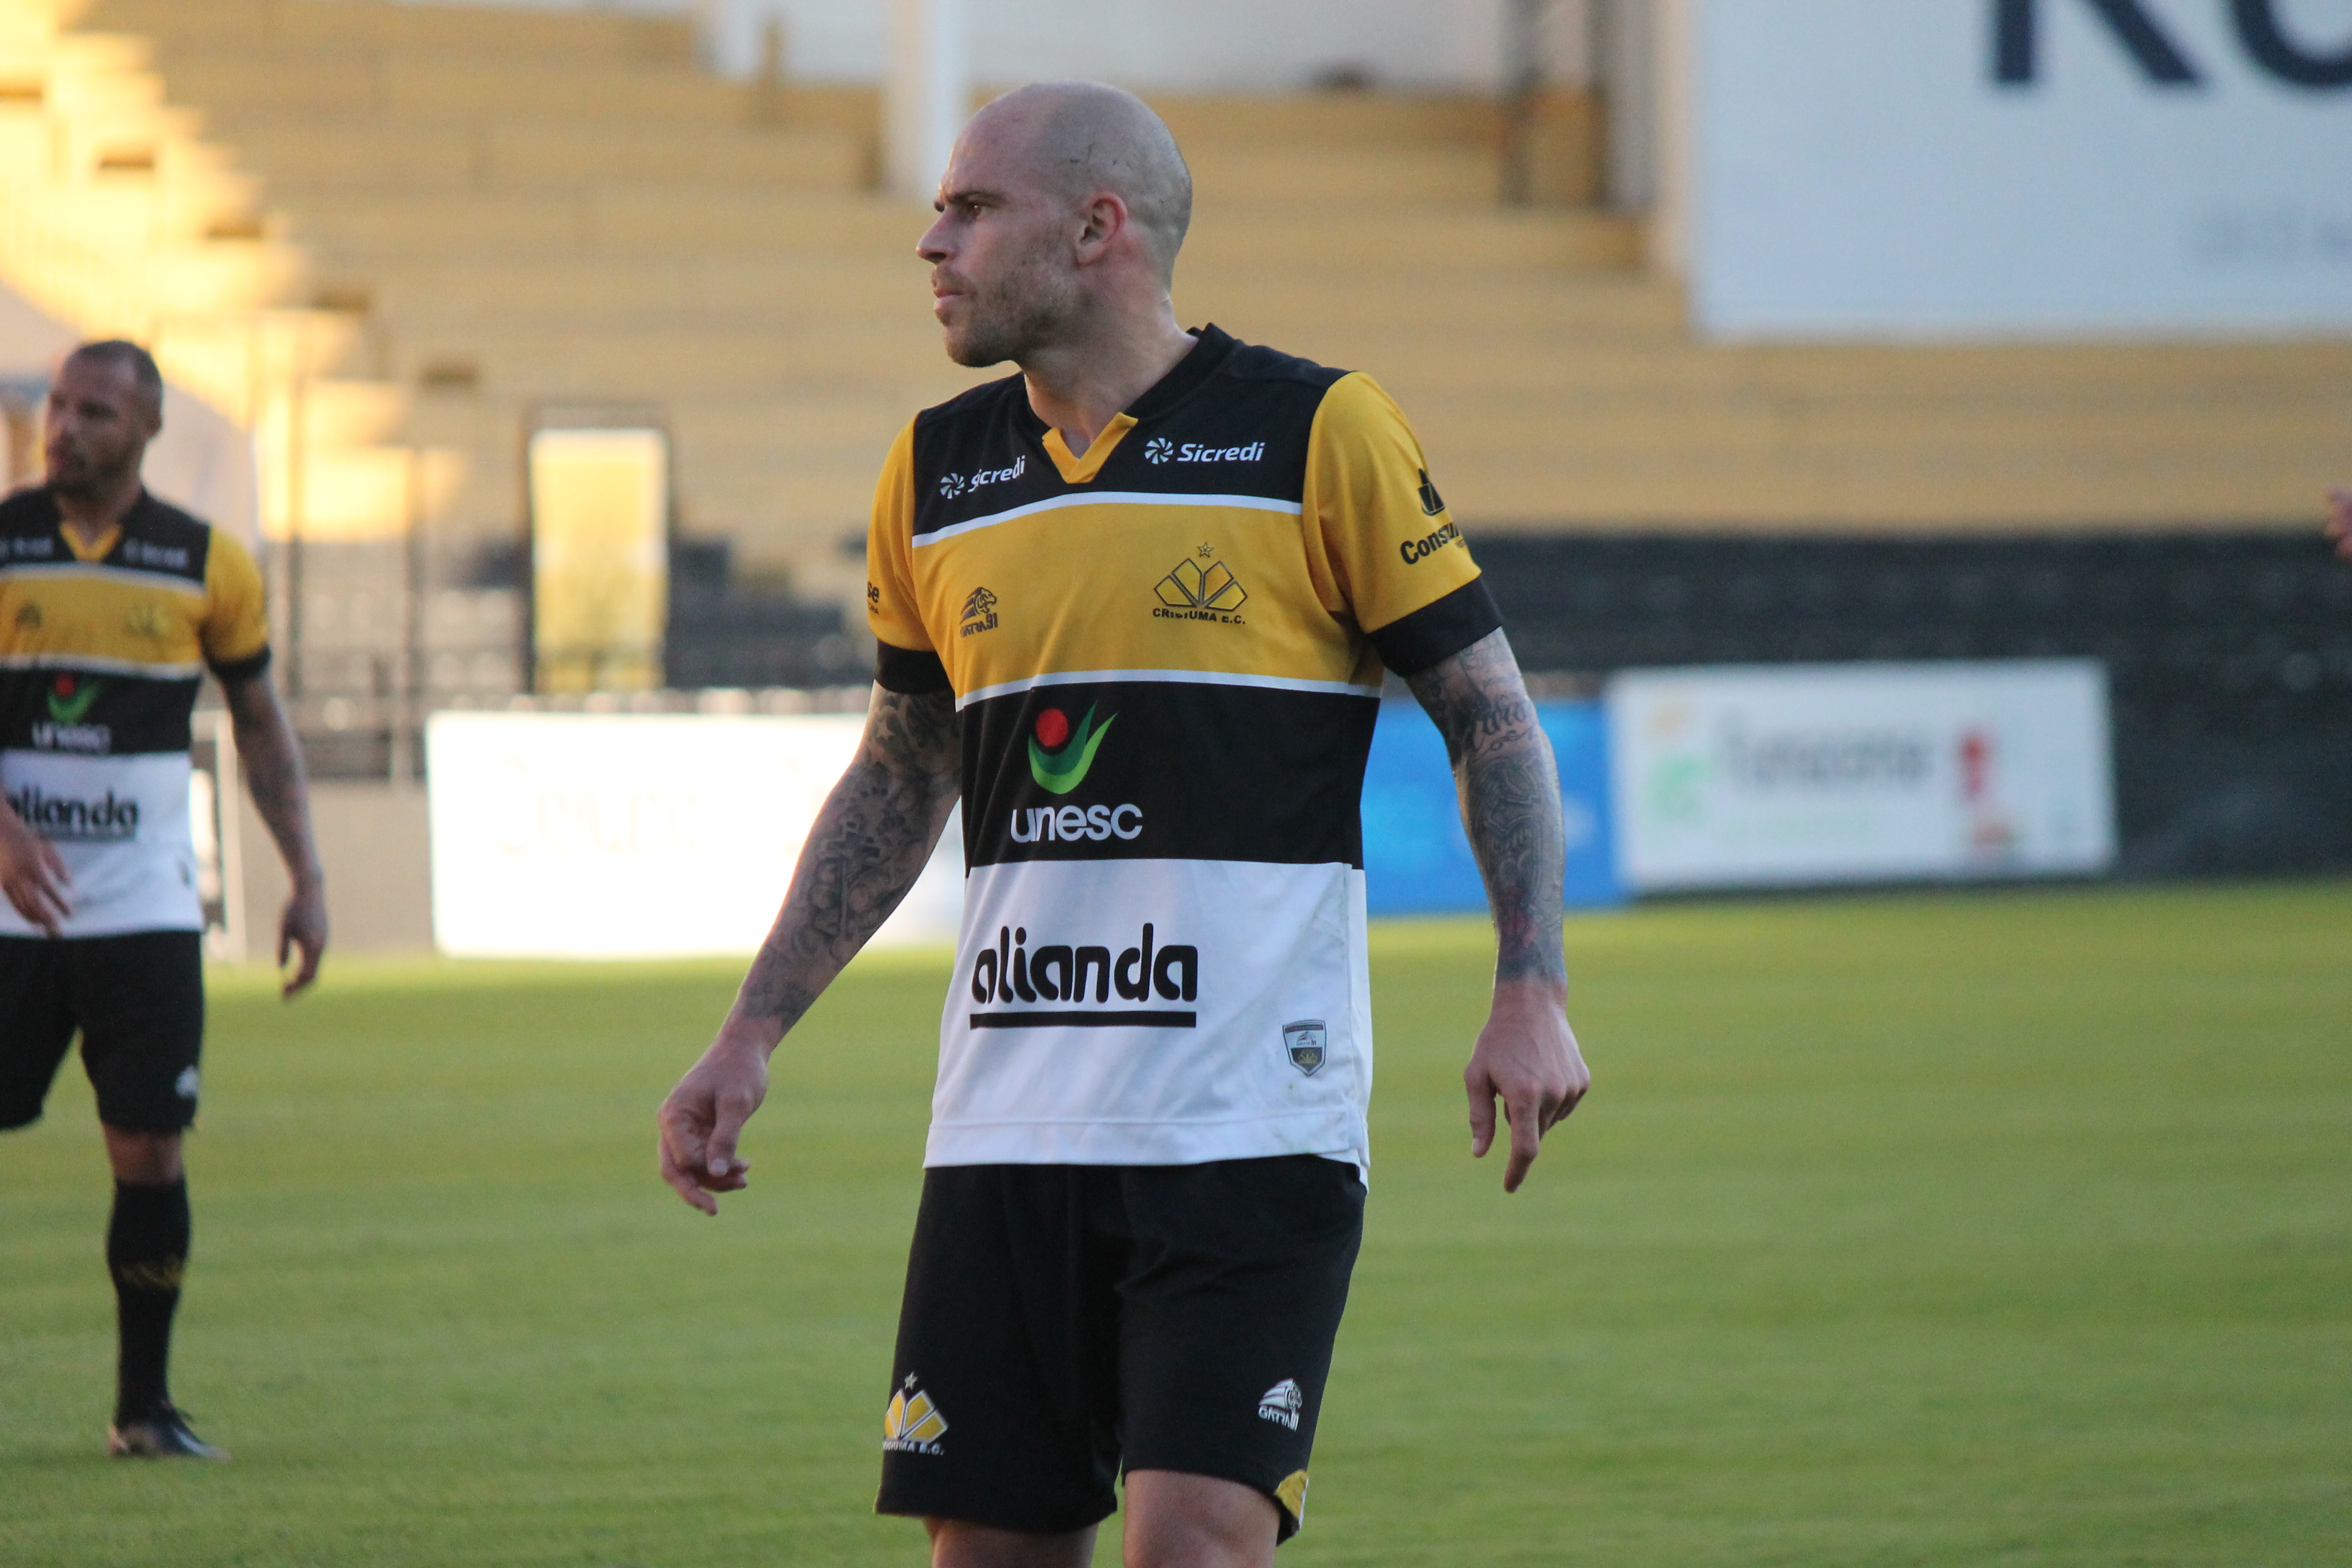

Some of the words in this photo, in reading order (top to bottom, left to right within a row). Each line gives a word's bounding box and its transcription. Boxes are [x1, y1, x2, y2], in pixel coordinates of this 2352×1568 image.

[1176, 442, 1266, 463] Sicredi
[1221, 614, 1246, 624] E.C.
[1009, 803, 1144, 843] unesc
[971, 922, 1199, 1005] alianda
